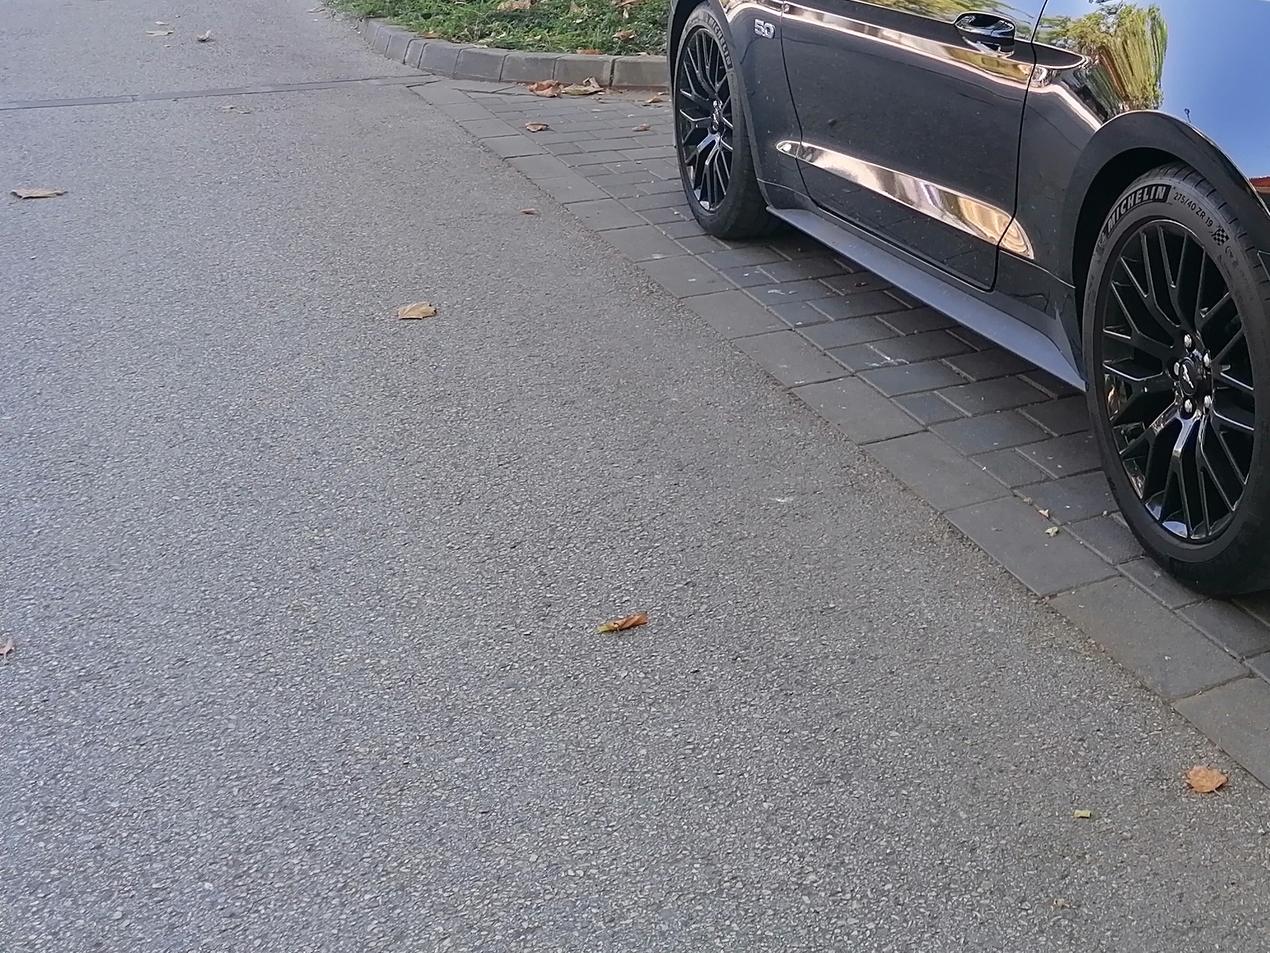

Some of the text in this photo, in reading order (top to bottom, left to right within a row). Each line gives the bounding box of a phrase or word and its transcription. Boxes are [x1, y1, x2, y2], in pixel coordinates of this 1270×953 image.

[1107, 186, 1167, 233] MICHELIN
[1173, 192, 1214, 227] 275/40 ZR 19
